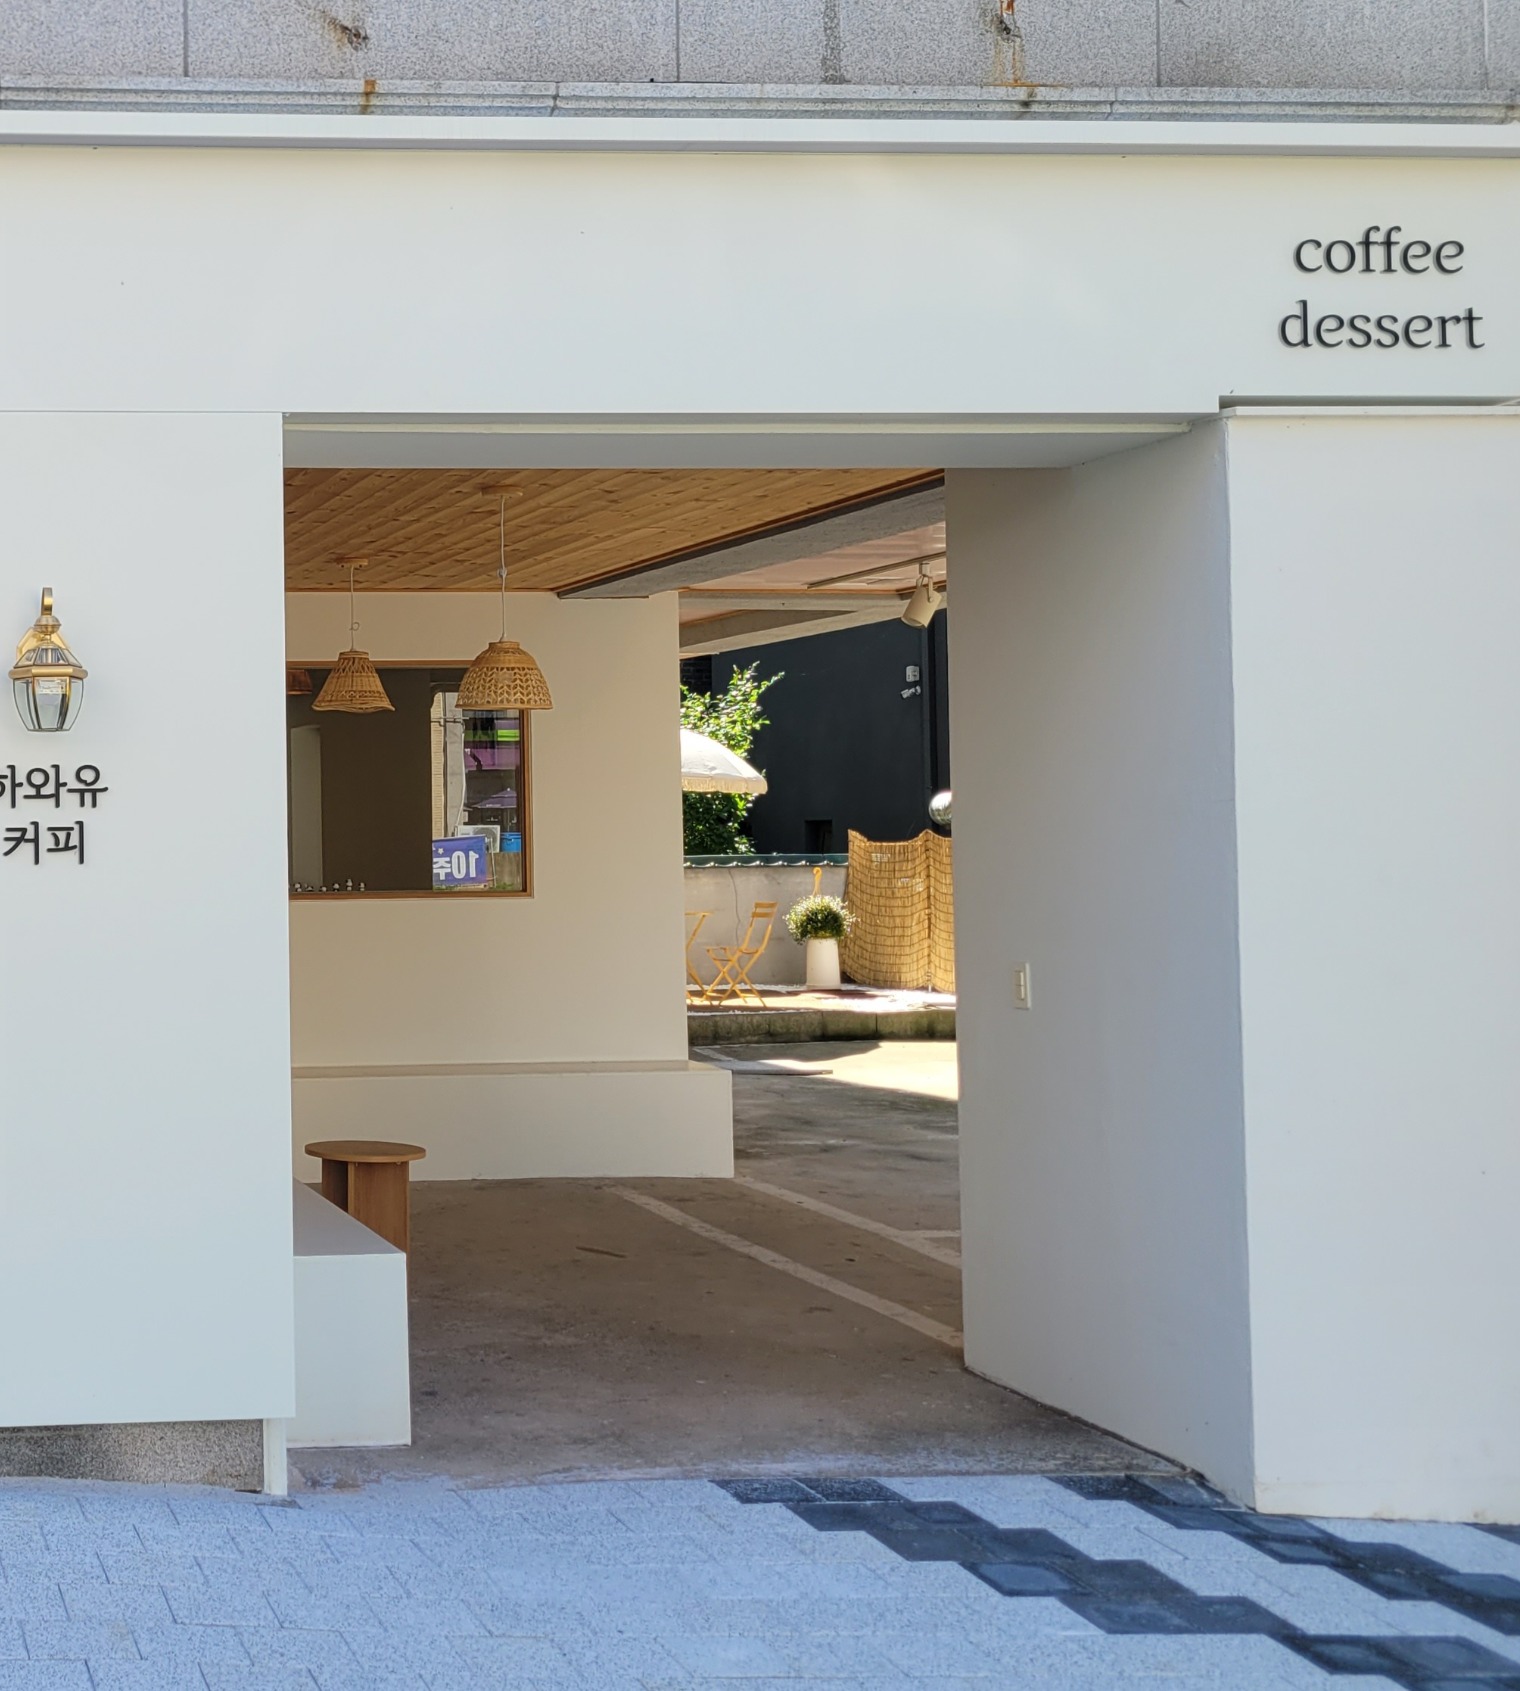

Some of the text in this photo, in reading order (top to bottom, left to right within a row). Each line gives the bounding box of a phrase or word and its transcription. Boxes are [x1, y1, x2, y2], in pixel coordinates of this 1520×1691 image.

[1293, 225, 1464, 275] coffee
[1279, 299, 1485, 350] dessert
[2, 820, 85, 866] 커피
